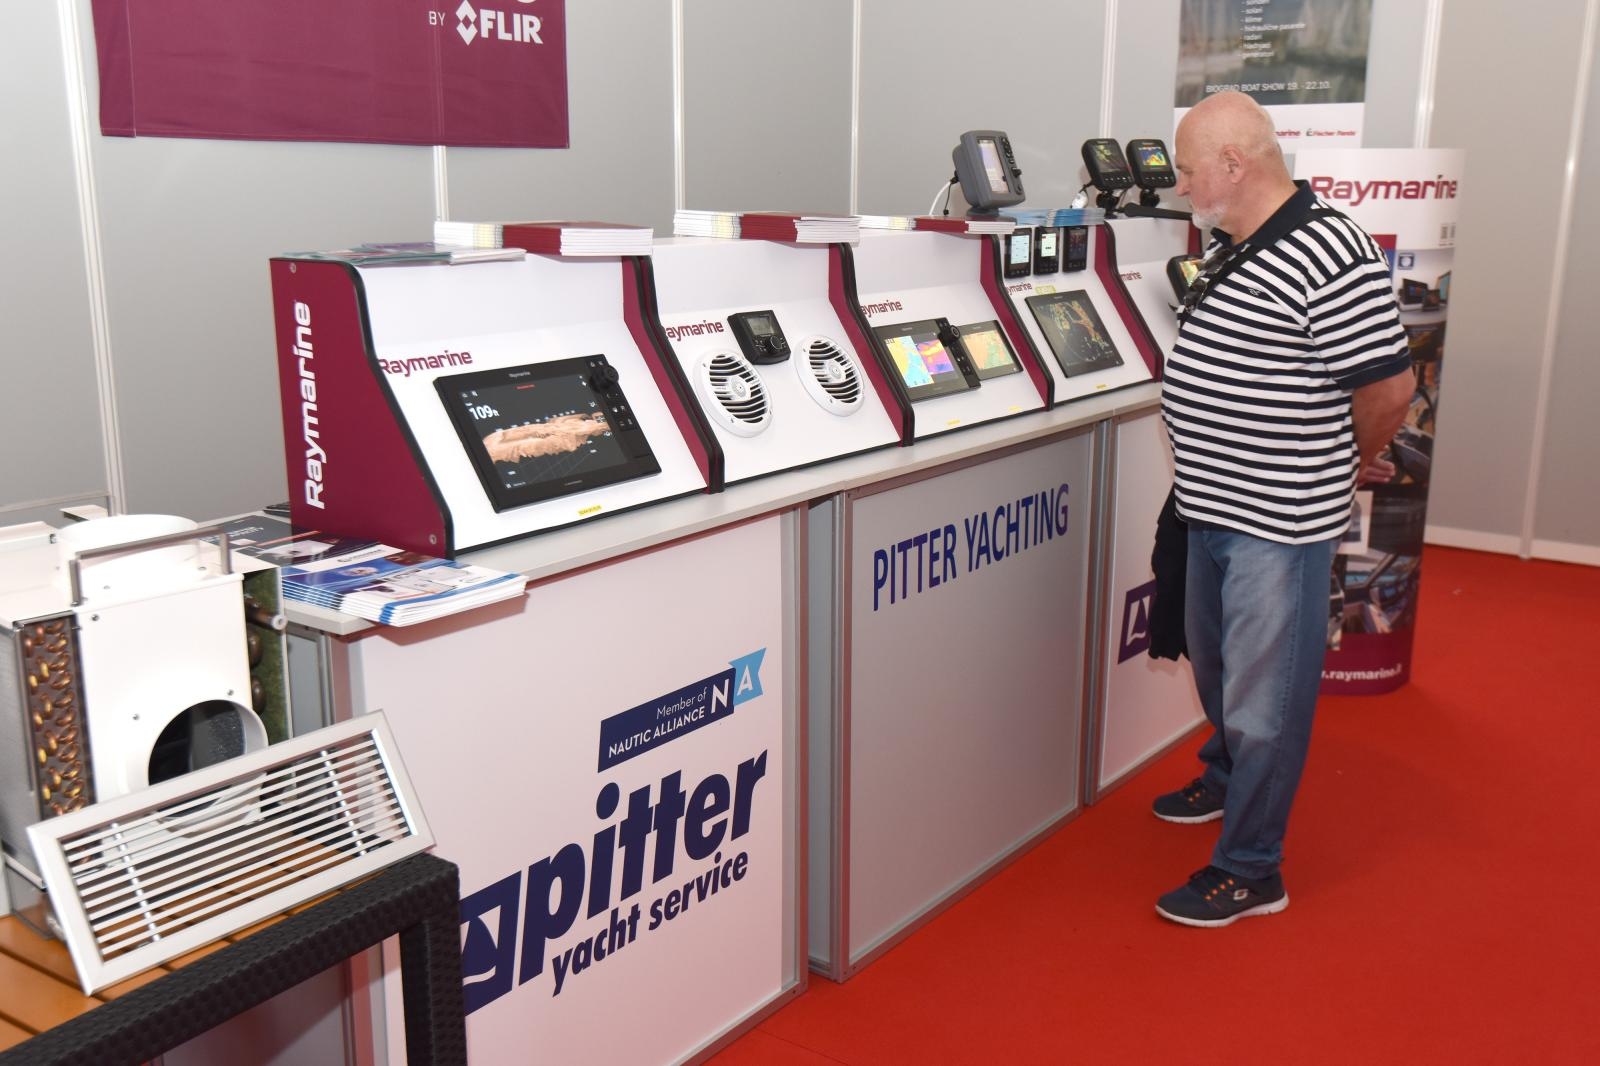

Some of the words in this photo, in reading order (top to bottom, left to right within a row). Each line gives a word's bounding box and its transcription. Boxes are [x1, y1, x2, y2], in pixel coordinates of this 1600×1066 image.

[428, 11, 446, 26] BY
[480, 9, 544, 45] FLIR
[1241, 83, 1260, 92] BOAT
[1262, 82, 1285, 91] SHOW
[1311, 174, 1458, 207] Raymarine
[664, 319, 725, 341] aymarine
[378, 349, 473, 378] Raymarine
[293, 302, 327, 510] Raymarine
[873, 523, 957, 612] PITTER
[964, 483, 1069, 573] YACHTING
[656, 696, 696, 719] Member
[697, 687, 708, 703] of
[608, 729, 651, 758] NAUTIC
[653, 705, 706, 740] ALLIANCE
[518, 749, 768, 987] pitter
[552, 902, 641, 998] yacht
[648, 850, 749, 931] service
